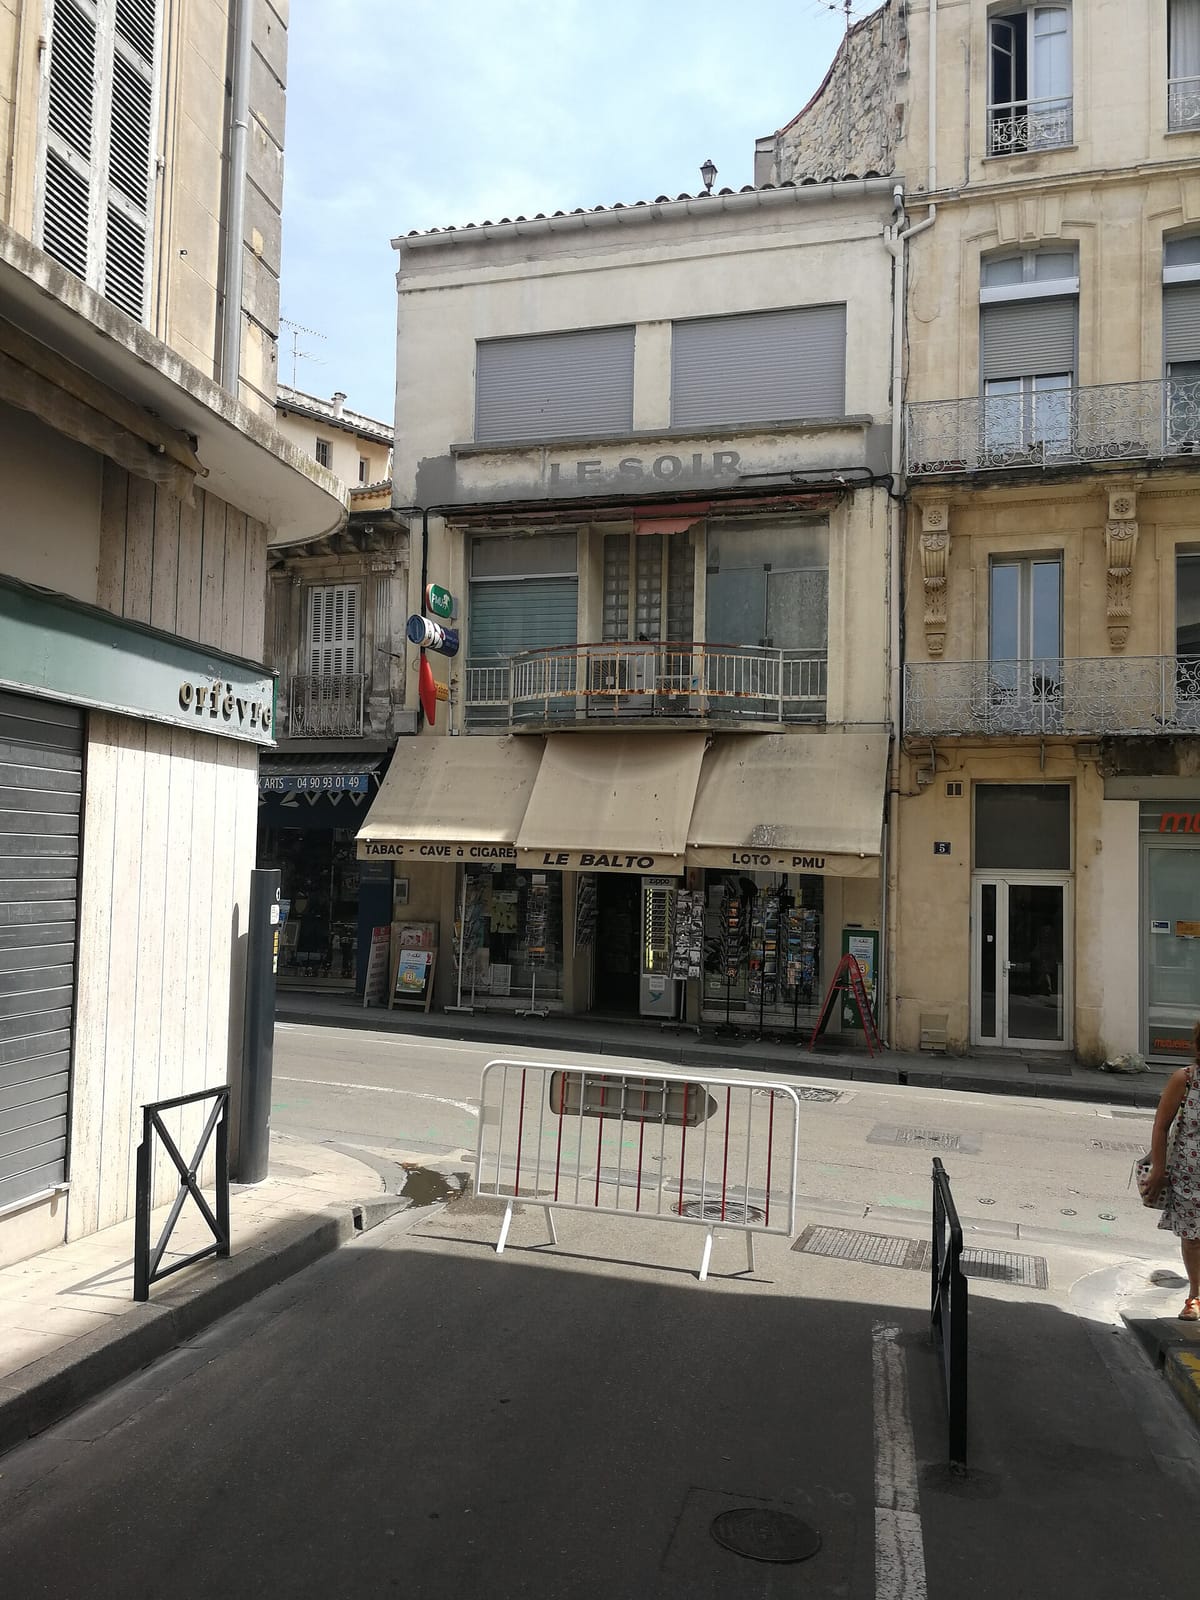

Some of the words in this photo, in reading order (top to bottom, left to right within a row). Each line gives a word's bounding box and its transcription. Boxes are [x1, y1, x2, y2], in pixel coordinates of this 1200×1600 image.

[550, 460, 602, 484] LE
[619, 451, 742, 481] SOIR
[179, 680, 272, 730] orfèvre
[264, 778, 284, 789] ARTS
[297, 778, 307, 788] 04
[310, 778, 320, 788] 90
[323, 777, 333, 787] 93
[335, 776, 345, 787] 01
[349, 776, 360, 787] 49
[365, 844, 404, 855] TABAC
[420, 846, 451, 856] CAVE
[456, 846, 464, 857] à
[939, 843, 946, 853] 5
[543, 853, 569, 865] LE
[579, 854, 655, 868] BALTO
[732, 853, 771, 865] LOTO
[792, 857, 825, 869] PMU
